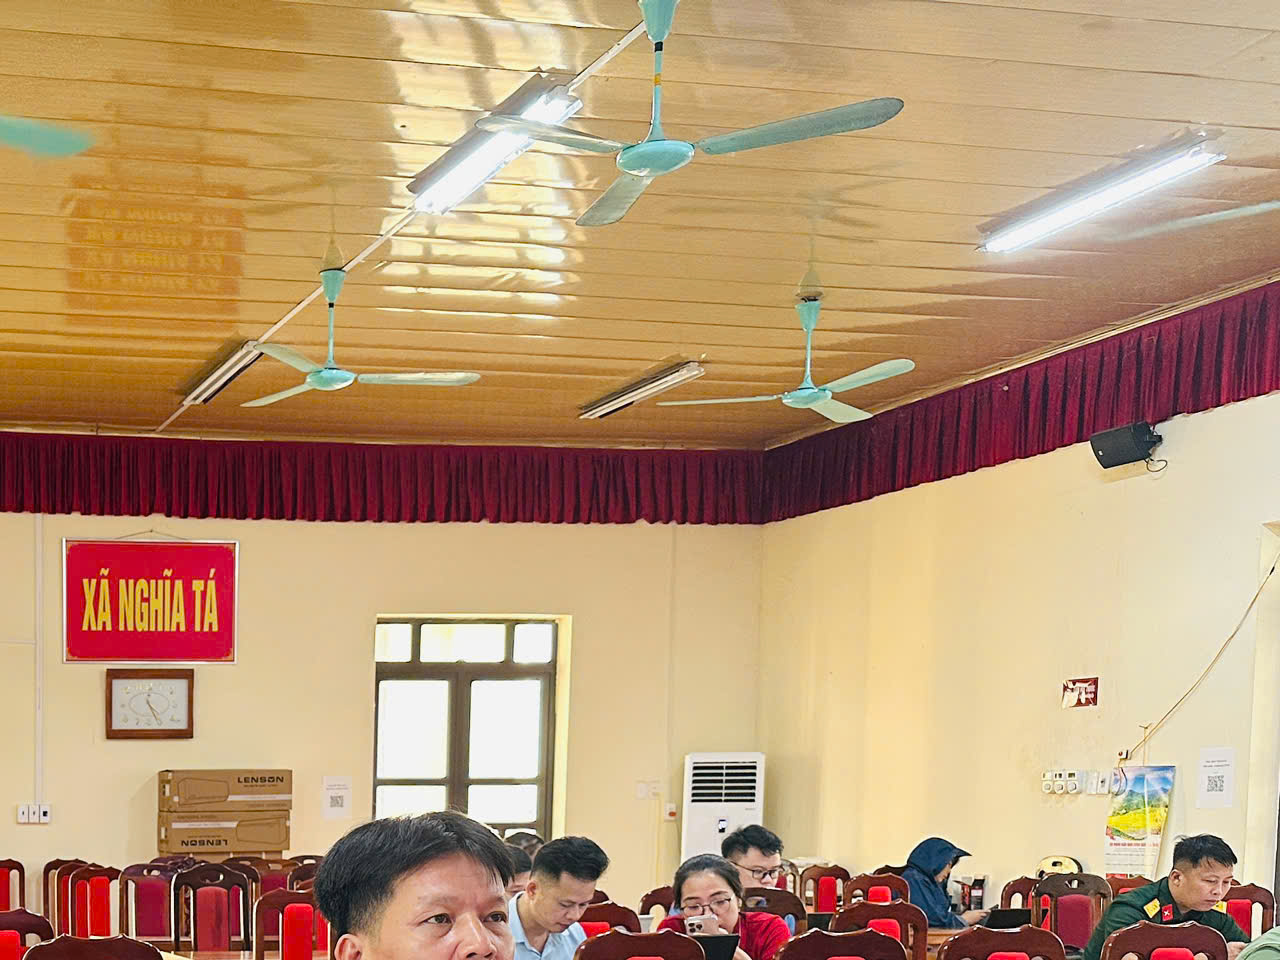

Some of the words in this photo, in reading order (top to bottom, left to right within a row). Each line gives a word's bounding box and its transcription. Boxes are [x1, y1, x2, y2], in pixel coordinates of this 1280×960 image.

[82, 568, 112, 631] XÃ
[119, 569, 185, 632] NGHĨA
[192, 569, 218, 632] TÁ
